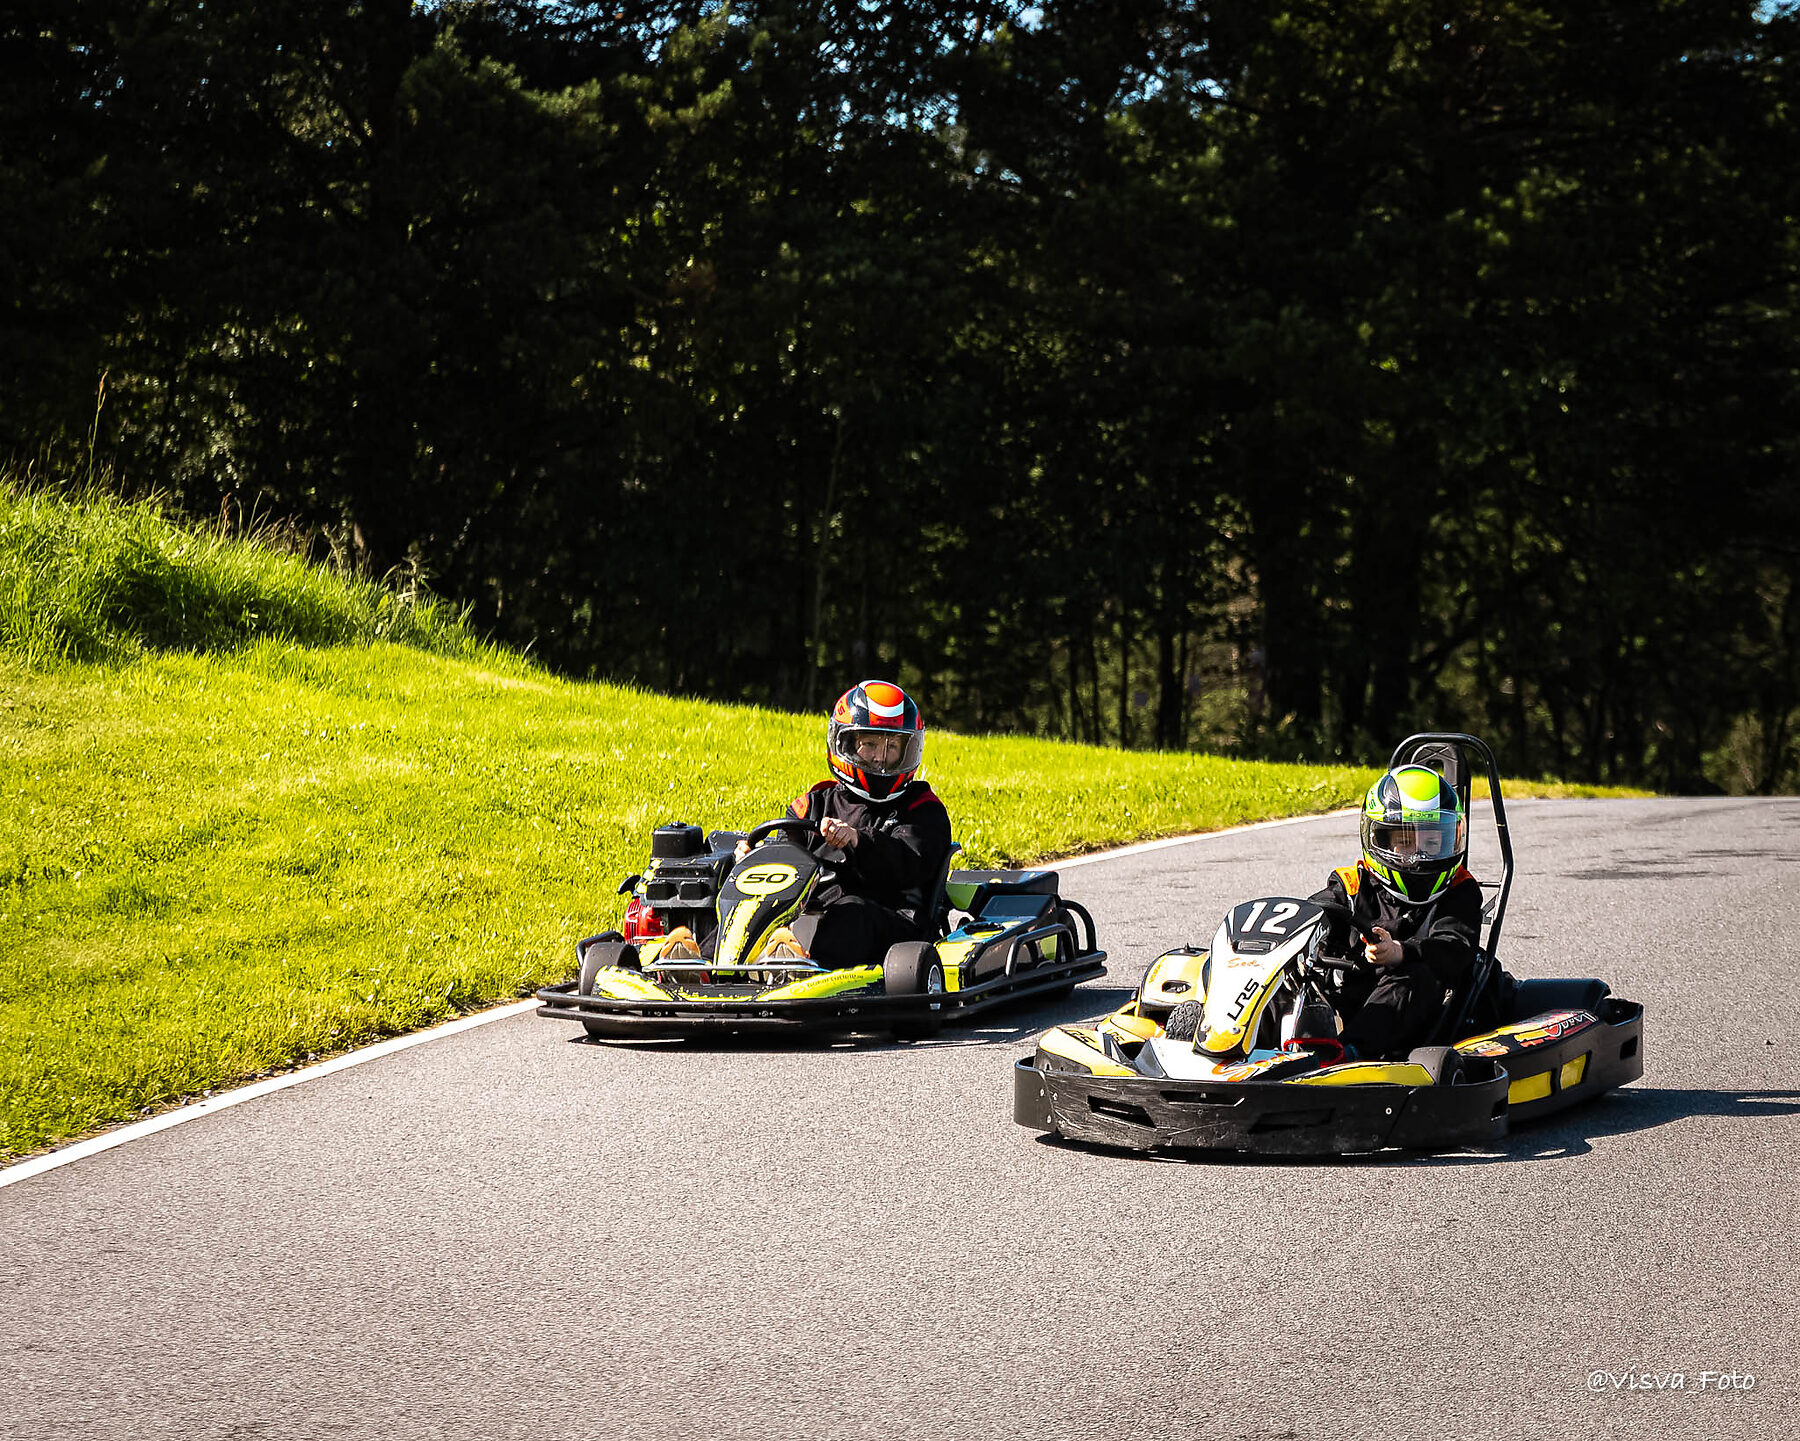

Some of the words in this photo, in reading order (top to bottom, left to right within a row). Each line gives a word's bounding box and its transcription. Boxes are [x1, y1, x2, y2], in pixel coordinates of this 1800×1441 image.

[743, 873, 789, 884] 50
[1240, 901, 1300, 935] 12
[1226, 978, 1260, 1021] LRS
